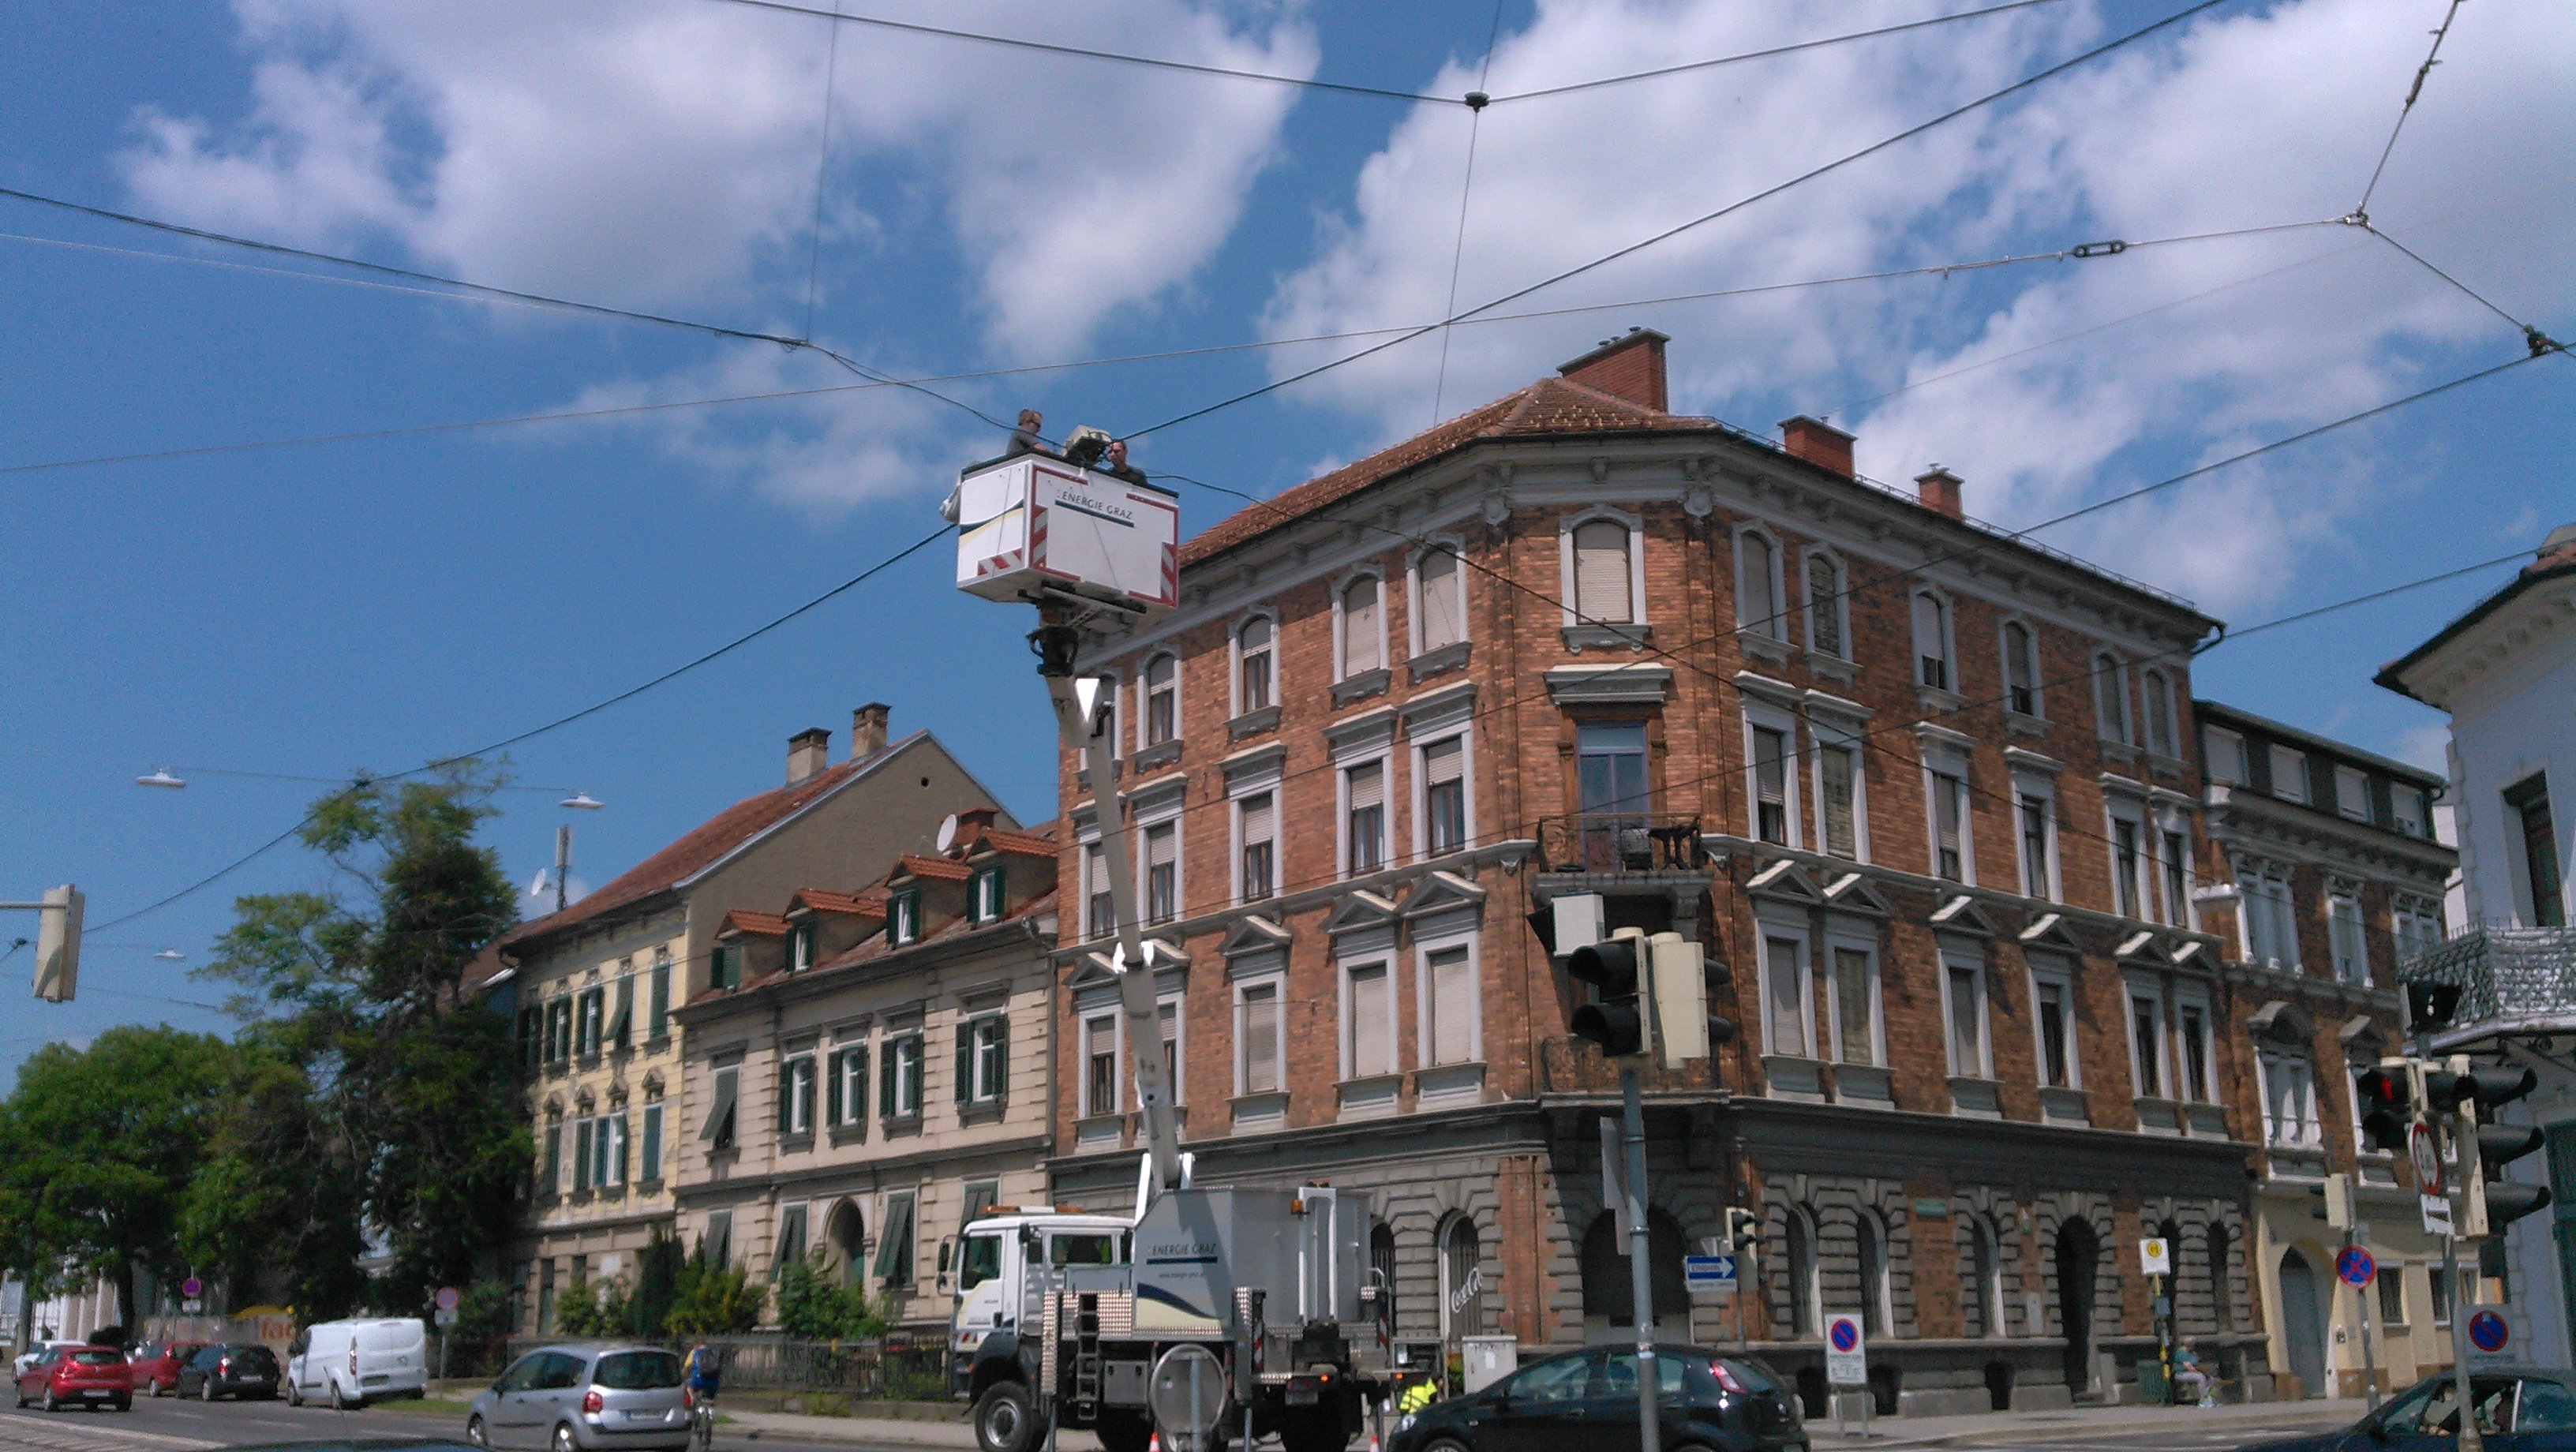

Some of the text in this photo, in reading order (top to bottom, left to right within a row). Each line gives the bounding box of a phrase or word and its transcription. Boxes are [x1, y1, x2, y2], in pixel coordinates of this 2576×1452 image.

[1061, 491, 1133, 520] ENERGIE GRAZ
[1151, 1243, 1217, 1256] ENERGIE GRAZ
